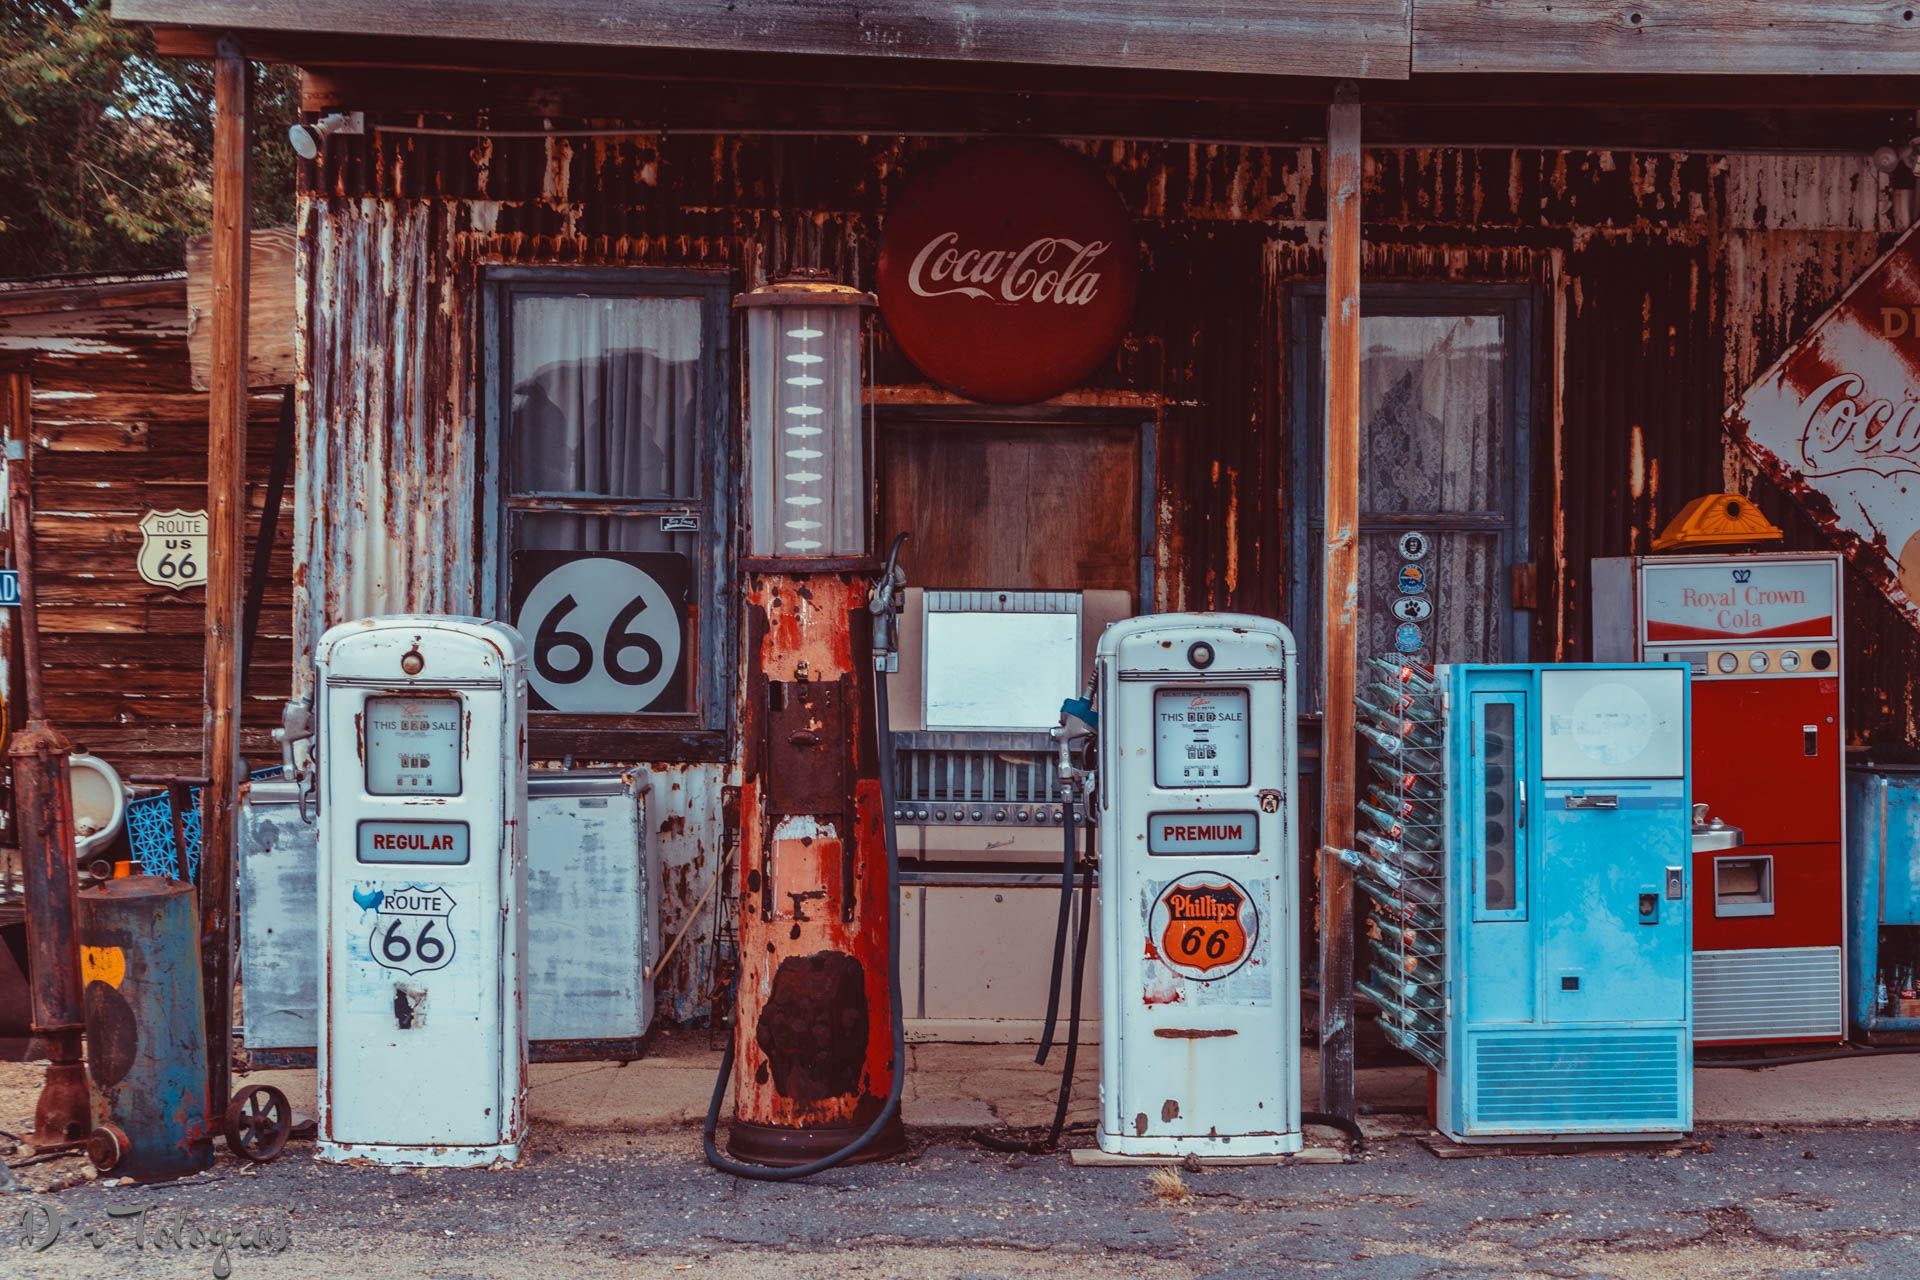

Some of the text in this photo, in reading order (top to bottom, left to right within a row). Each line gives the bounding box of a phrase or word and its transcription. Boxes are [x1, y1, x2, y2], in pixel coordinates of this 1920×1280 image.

[907, 231, 1113, 306] Coca-Cola
[156, 520, 201, 533] ROUTE
[165, 539, 192, 550] US
[158, 552, 197, 579] 66
[1682, 585, 1807, 612] Royal Crown
[1716, 609, 1763, 629] Cola
[533, 593, 664, 686] 66
[374, 720, 397, 730] THIS
[432, 721, 457, 731] SALE
[1160, 713, 1184, 722] THIS
[1218, 712, 1243, 721] SALE
[373, 834, 454, 850] REGULAR
[1163, 825, 1242, 841] PREMIUM
[384, 895, 442, 911] ROUTE
[1170, 895, 1236, 923] Phillips
[382, 918, 445, 963] 66
[1181, 926, 1230, 959] 66
